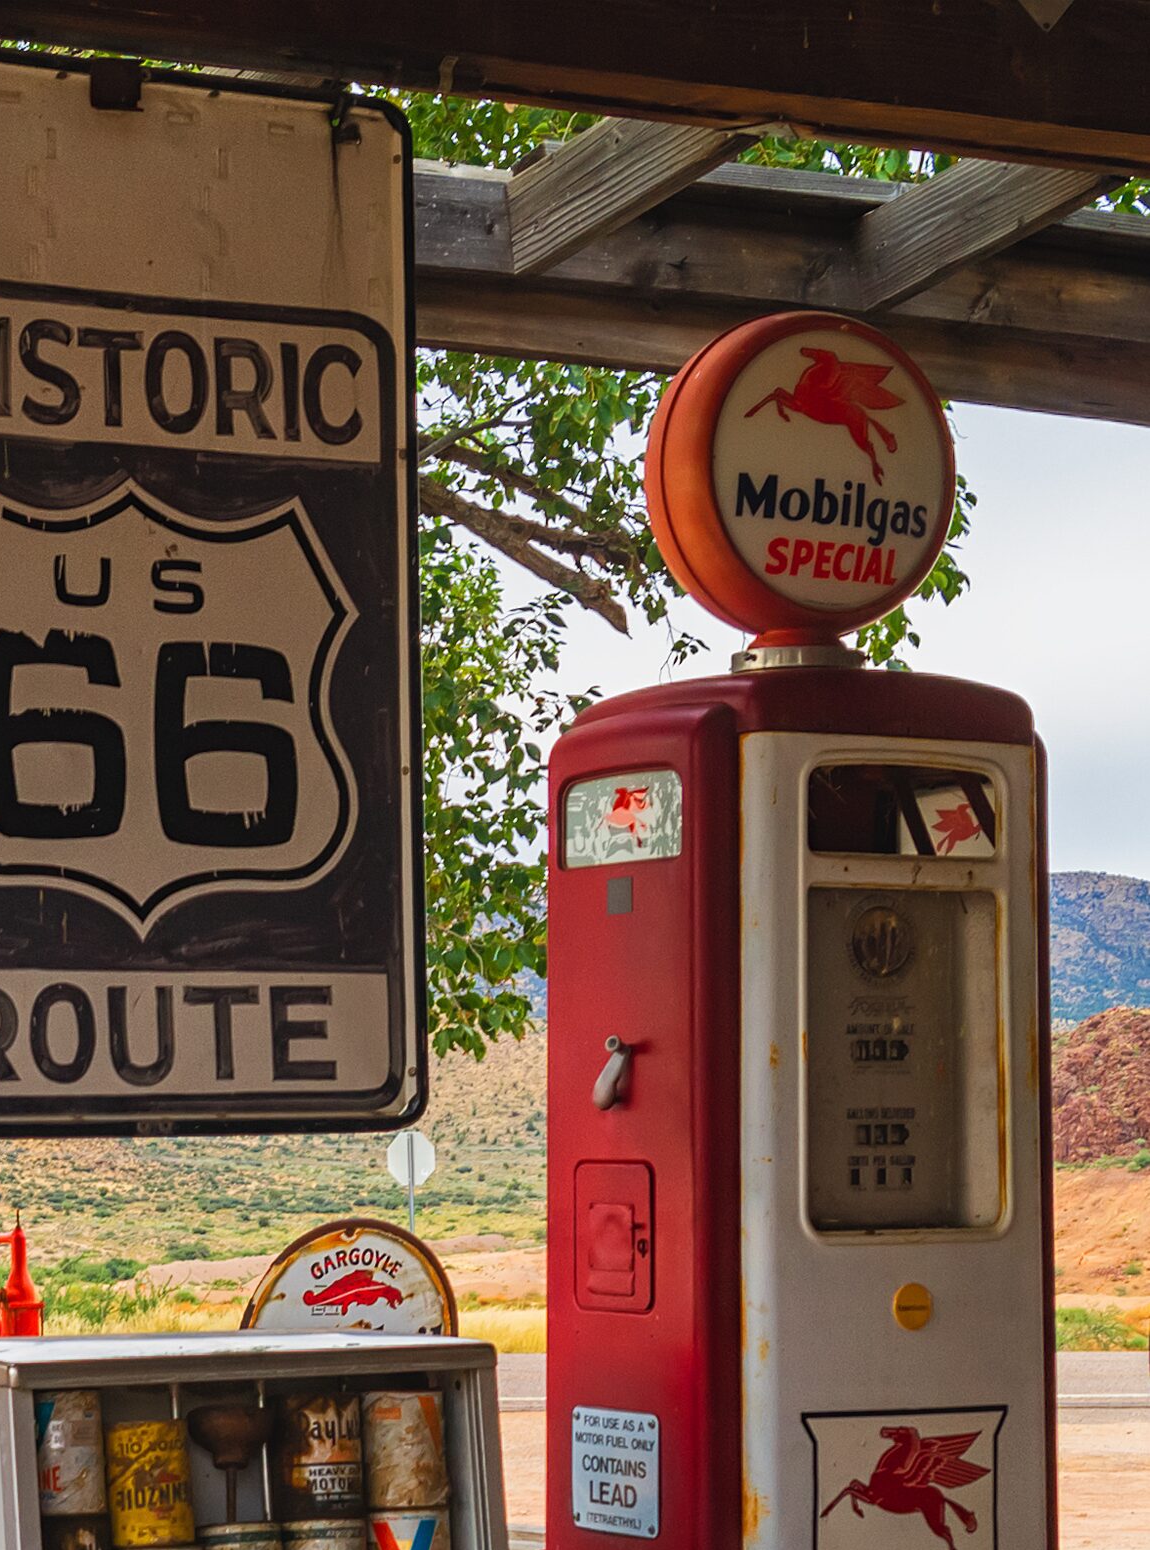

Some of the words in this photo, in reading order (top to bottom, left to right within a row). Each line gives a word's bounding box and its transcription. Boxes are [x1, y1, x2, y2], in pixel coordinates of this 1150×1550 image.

[734, 472, 928, 546] Mobilgas
[764, 536, 898, 587] SPECIAL
[310, 1247, 402, 1280] GARGOYLE
[584, 1415, 602, 1427] FOR
[602, 1417, 620, 1430] USE
[623, 1420, 635, 1432] AS
[637, 1421, 645, 1433] A
[575, 1432, 604, 1446] MOTOR
[606, 1435, 629, 1449] FUEL
[631, 1438, 656, 1452] ONLY
[581, 1453, 648, 1479] CONTAINS
[589, 1480, 638, 1509] LEAD
[586, 1511, 642, 1530] (TETRAETHYL)
